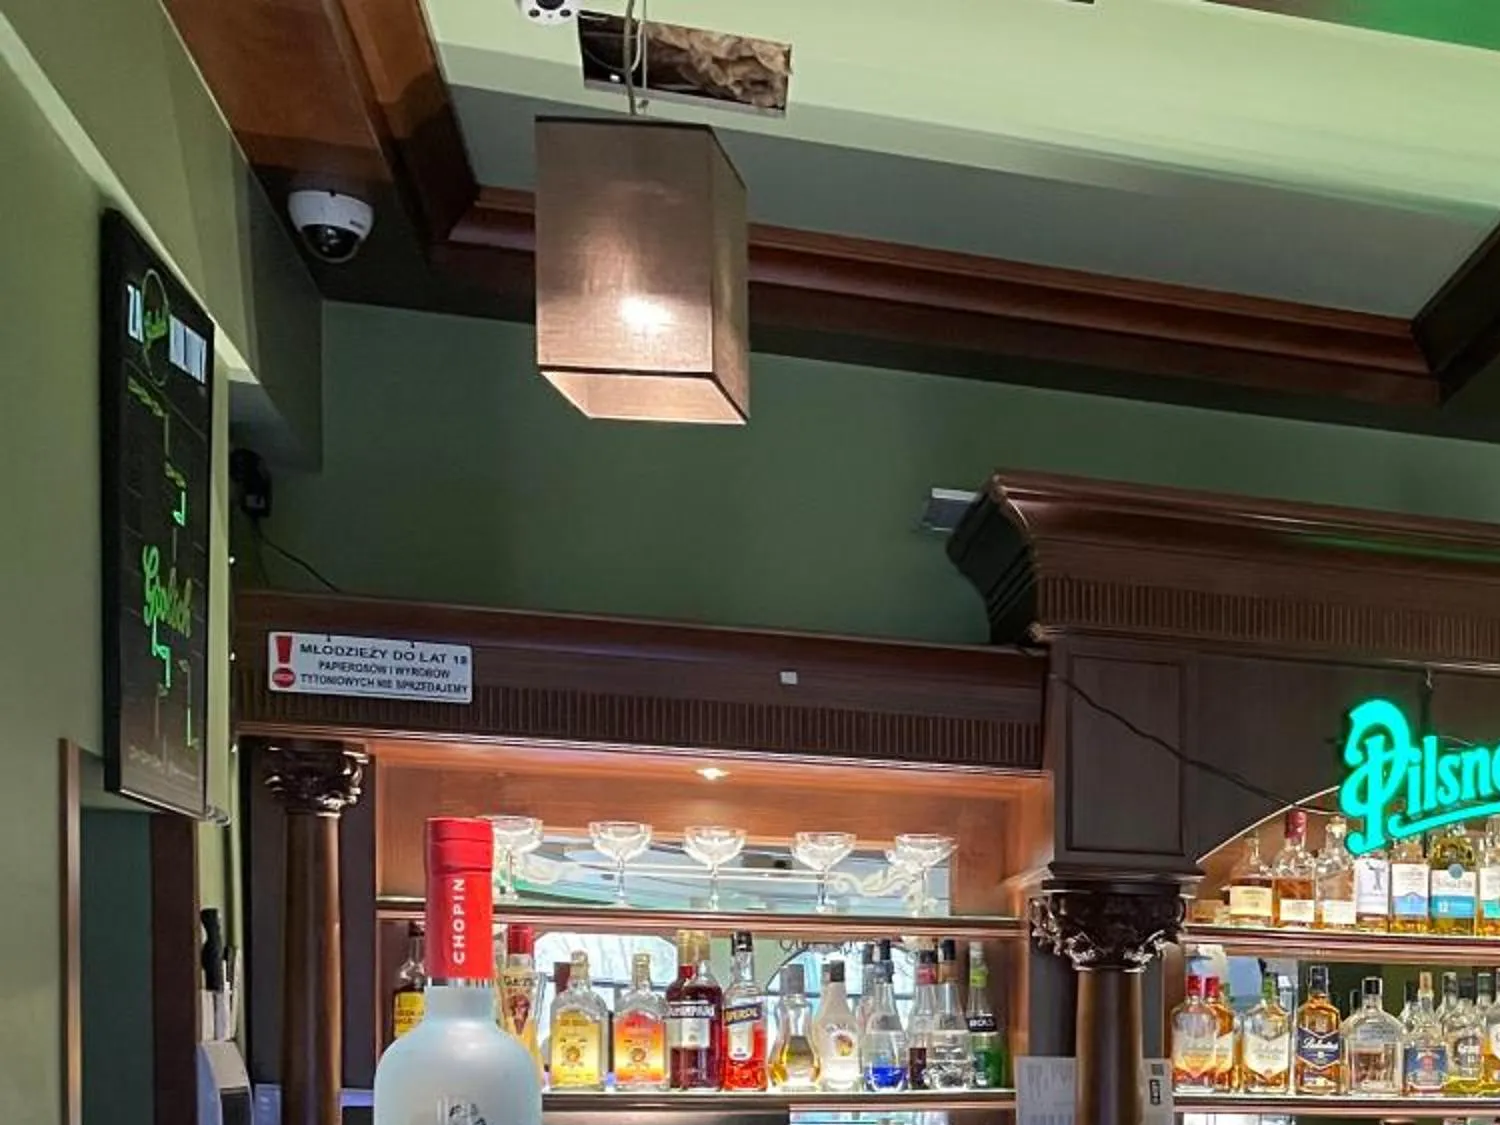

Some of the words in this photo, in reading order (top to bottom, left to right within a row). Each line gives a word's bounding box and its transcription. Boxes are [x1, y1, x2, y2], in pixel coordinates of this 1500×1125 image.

[300, 643, 387, 660] MŁODZIEŻY
[392, 650, 416, 662] DO
[418, 652, 448, 664] LAT
[452, 655, 468, 665] 18
[452, 877, 466, 965] CHOPIN
